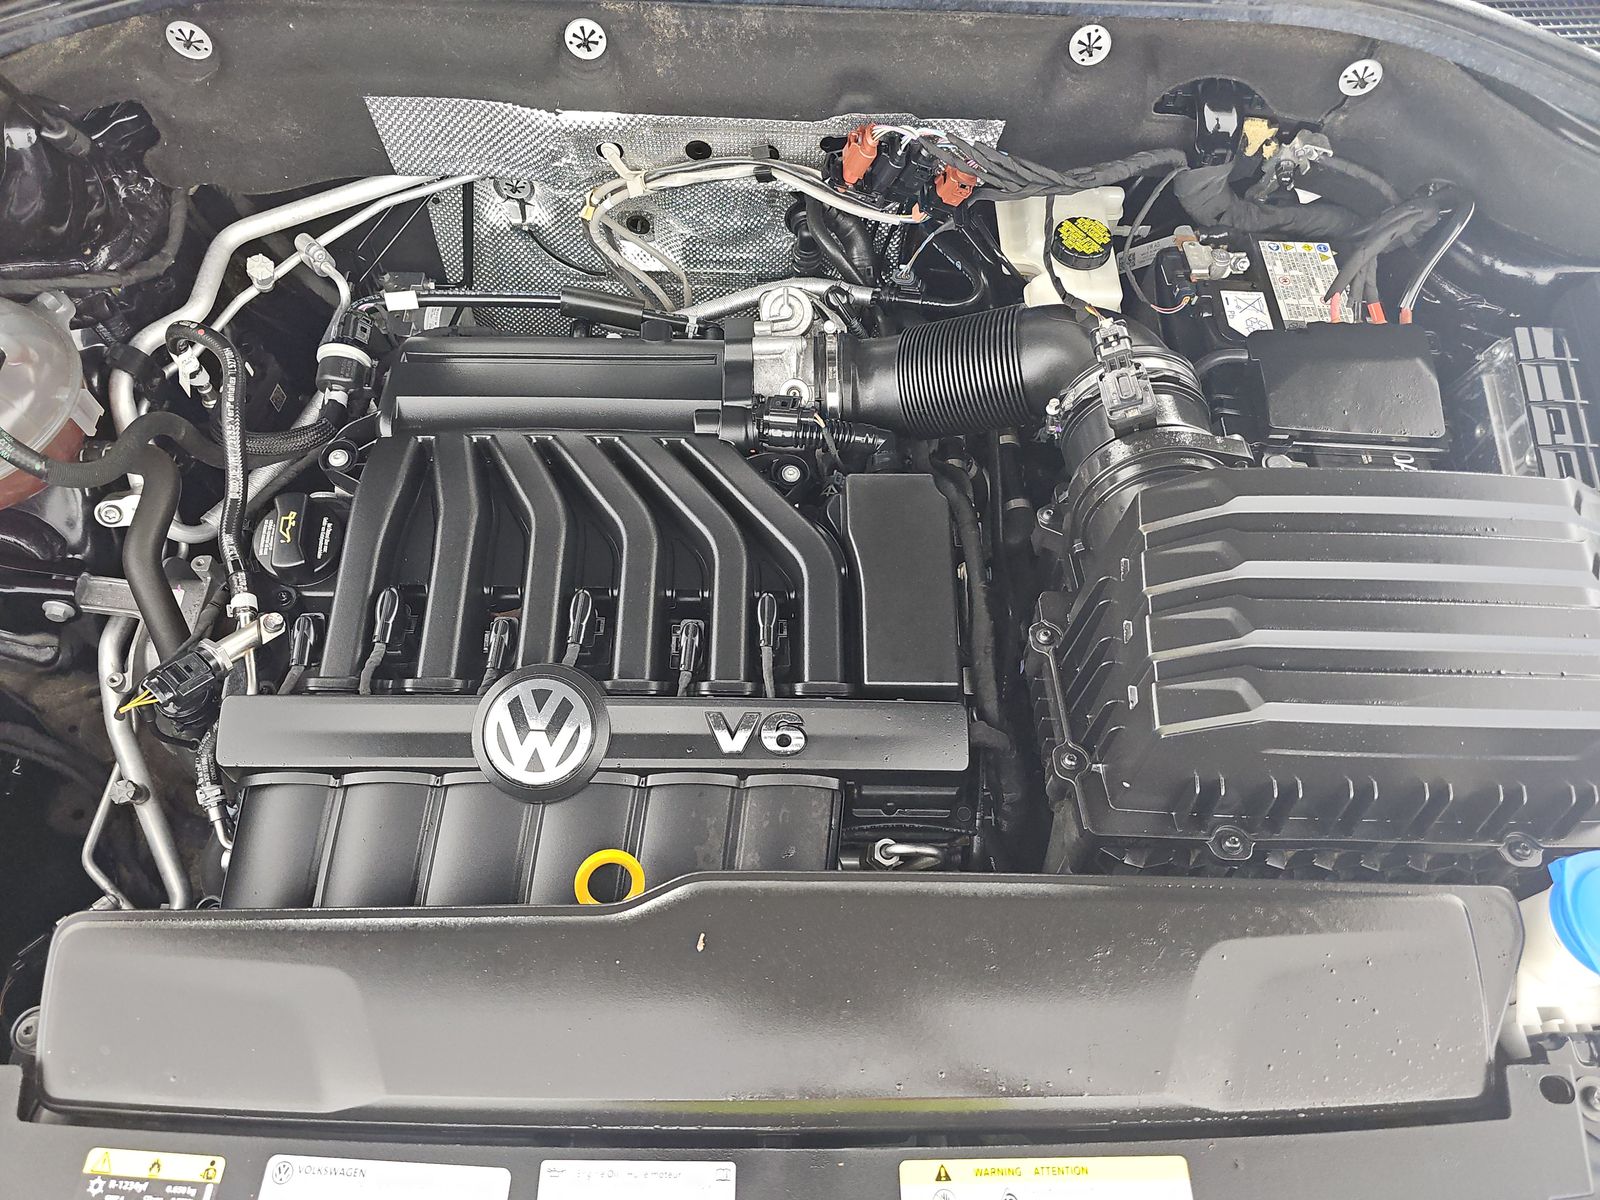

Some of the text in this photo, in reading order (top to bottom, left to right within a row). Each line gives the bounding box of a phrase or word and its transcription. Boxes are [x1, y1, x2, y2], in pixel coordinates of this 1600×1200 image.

[1227, 310, 1237, 320] Pb
[484, 678, 592, 785] VW
[704, 711, 808, 757] V6
[297, 1164, 367, 1179] VOLKSWAGEN
[973, 1166, 1089, 1177] WARNING ATTENTION
